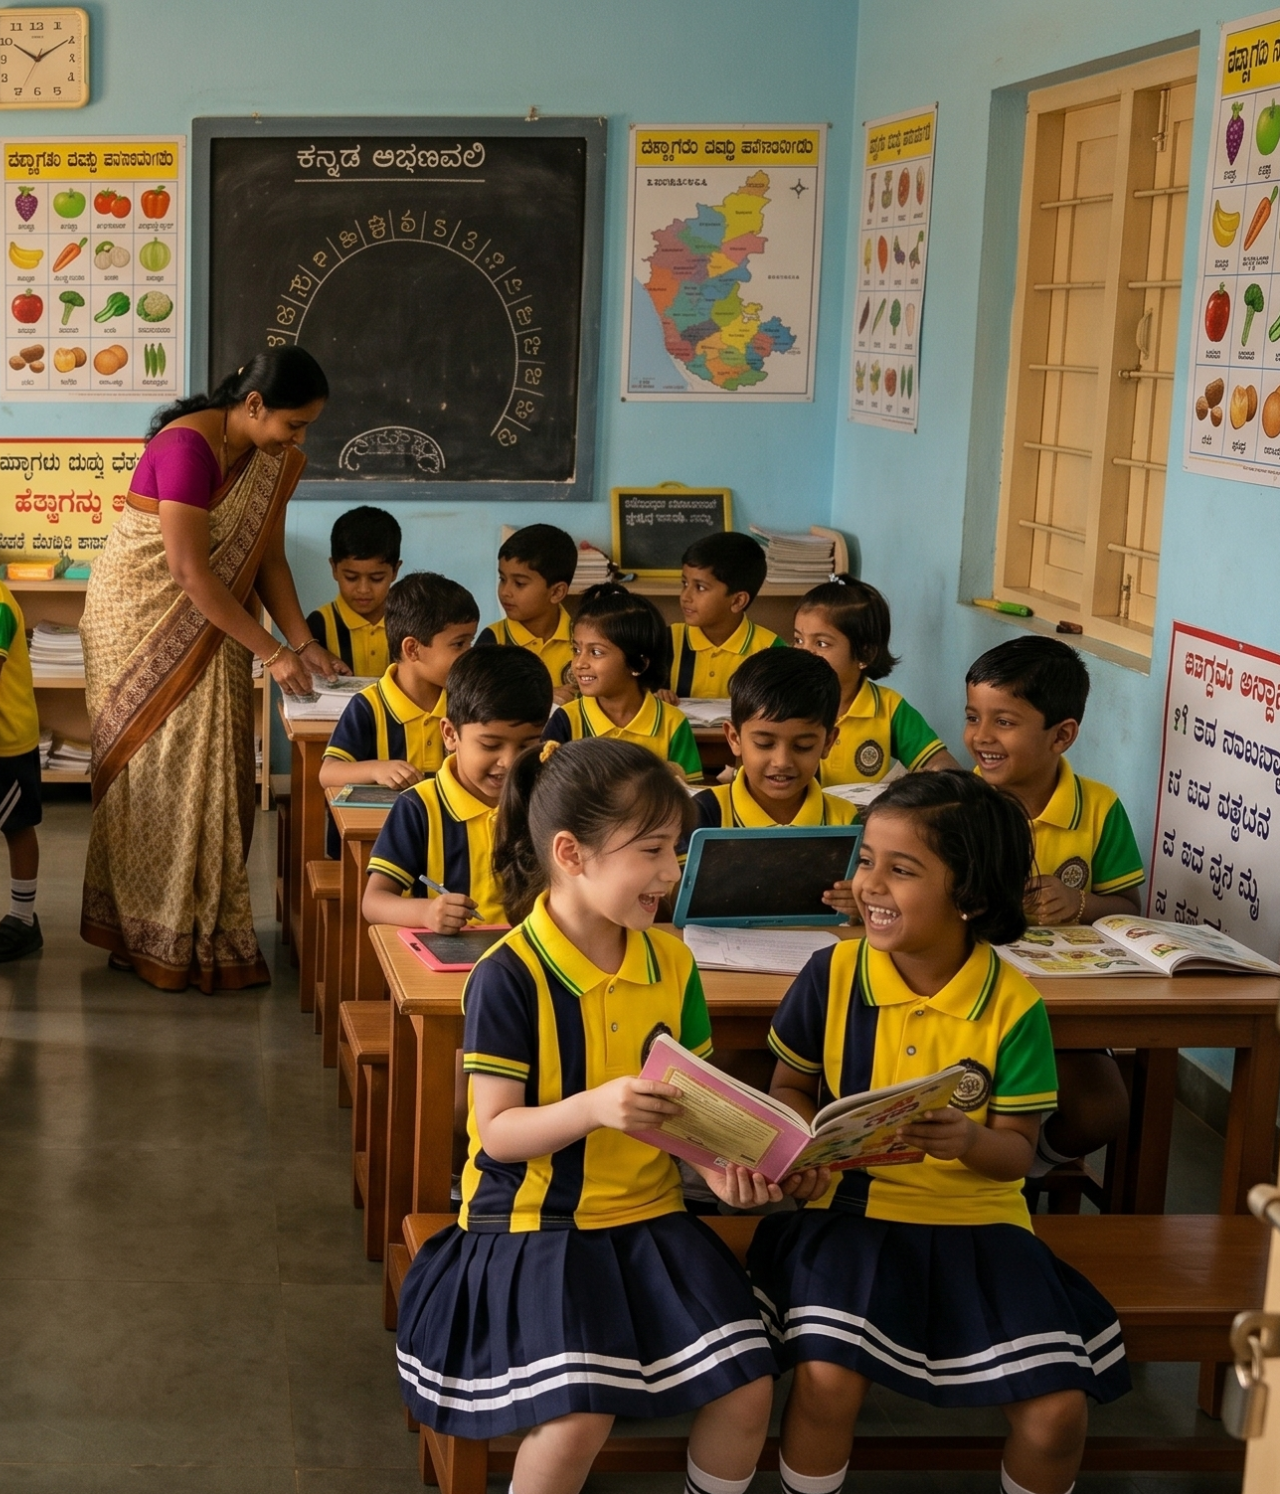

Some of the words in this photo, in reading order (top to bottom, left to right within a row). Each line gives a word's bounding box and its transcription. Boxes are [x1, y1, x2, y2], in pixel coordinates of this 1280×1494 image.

[10, 22, 23, 31] 11
[0, 37, 13, 46] 10
[0, 54, 7, 64] 9
[34, 87, 42, 96] 6
[297, 145, 361, 178] ಕನ್ನಡ
